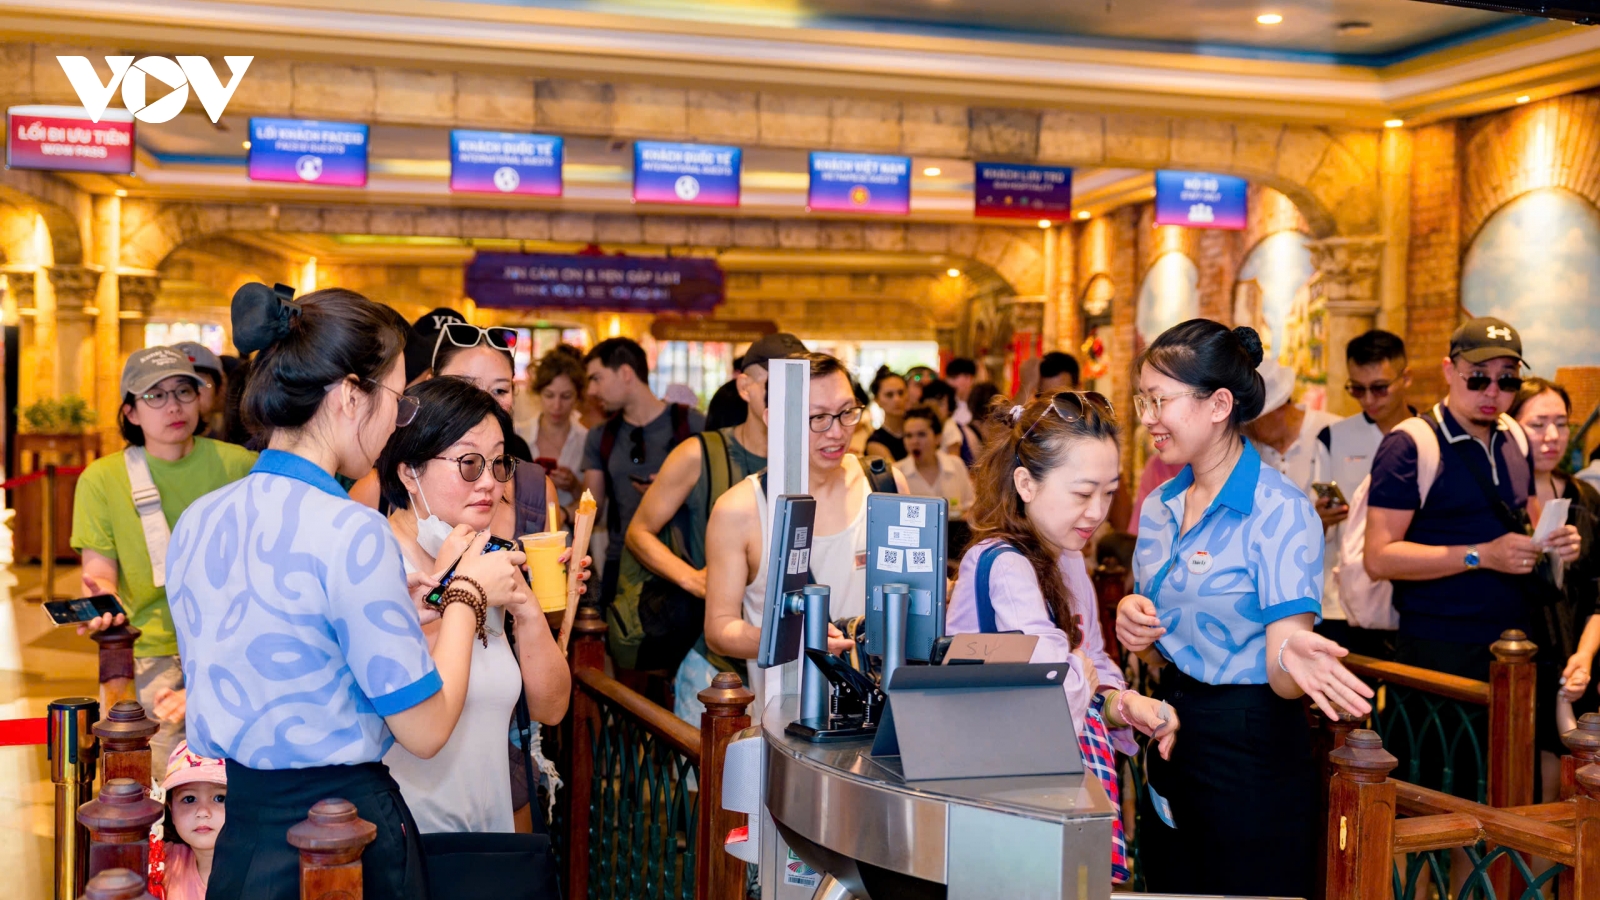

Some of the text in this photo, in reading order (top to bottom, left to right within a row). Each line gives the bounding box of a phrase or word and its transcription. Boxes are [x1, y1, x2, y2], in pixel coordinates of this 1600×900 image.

[18, 121, 46, 142] LỐI
[93, 128, 130, 147] TIÊN
[278, 126, 320, 143] KHÁCH
[40, 143, 108, 159] WOW PASS
[459, 138, 555, 156] KHÁCH QUỐC TẾ
[642, 148, 732, 166] KHÁCH QUỐC TẾ
[814, 158, 906, 176] KHÁCH VIỆT NAM
